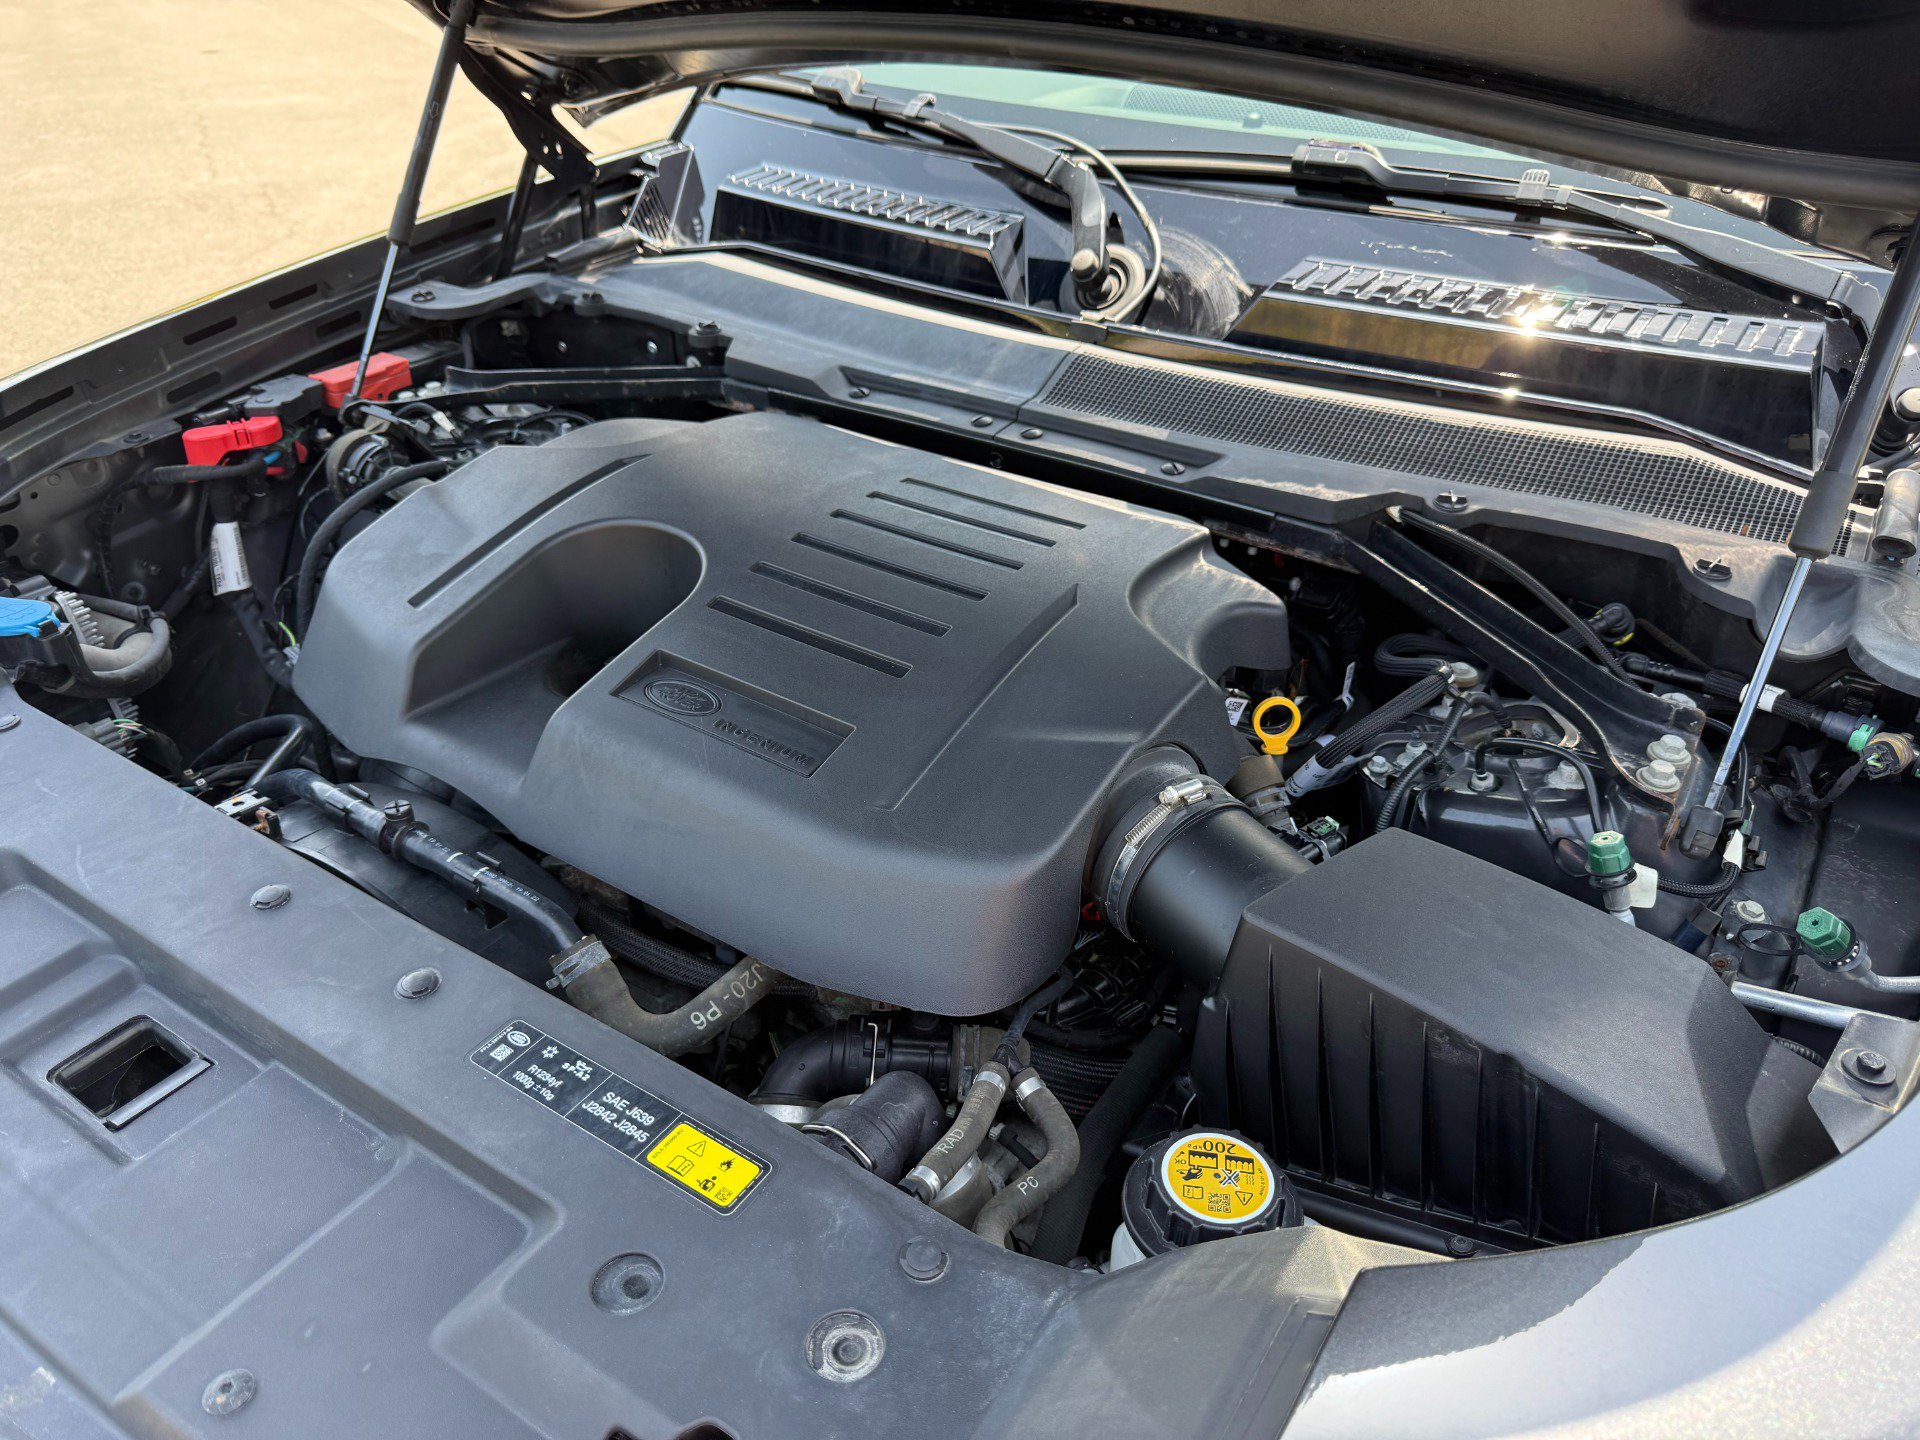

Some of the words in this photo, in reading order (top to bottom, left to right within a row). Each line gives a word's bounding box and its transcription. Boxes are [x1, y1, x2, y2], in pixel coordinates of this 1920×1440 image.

[712, 718, 816, 768] INGENIUM
[690, 999, 723, 1030] P6
[512, 1070, 536, 1089] 1000g
[527, 1064, 564, 1088] R1234yf
[581, 1100, 618, 1124] J2842
[613, 1119, 651, 1143] J2845
[602, 1091, 630, 1112] SAE
[625, 1106, 656, 1126] J639
[937, 1128, 965, 1155] RAD
[1202, 1140, 1237, 1155] 200
[1174, 1158, 1188, 1166] OK
